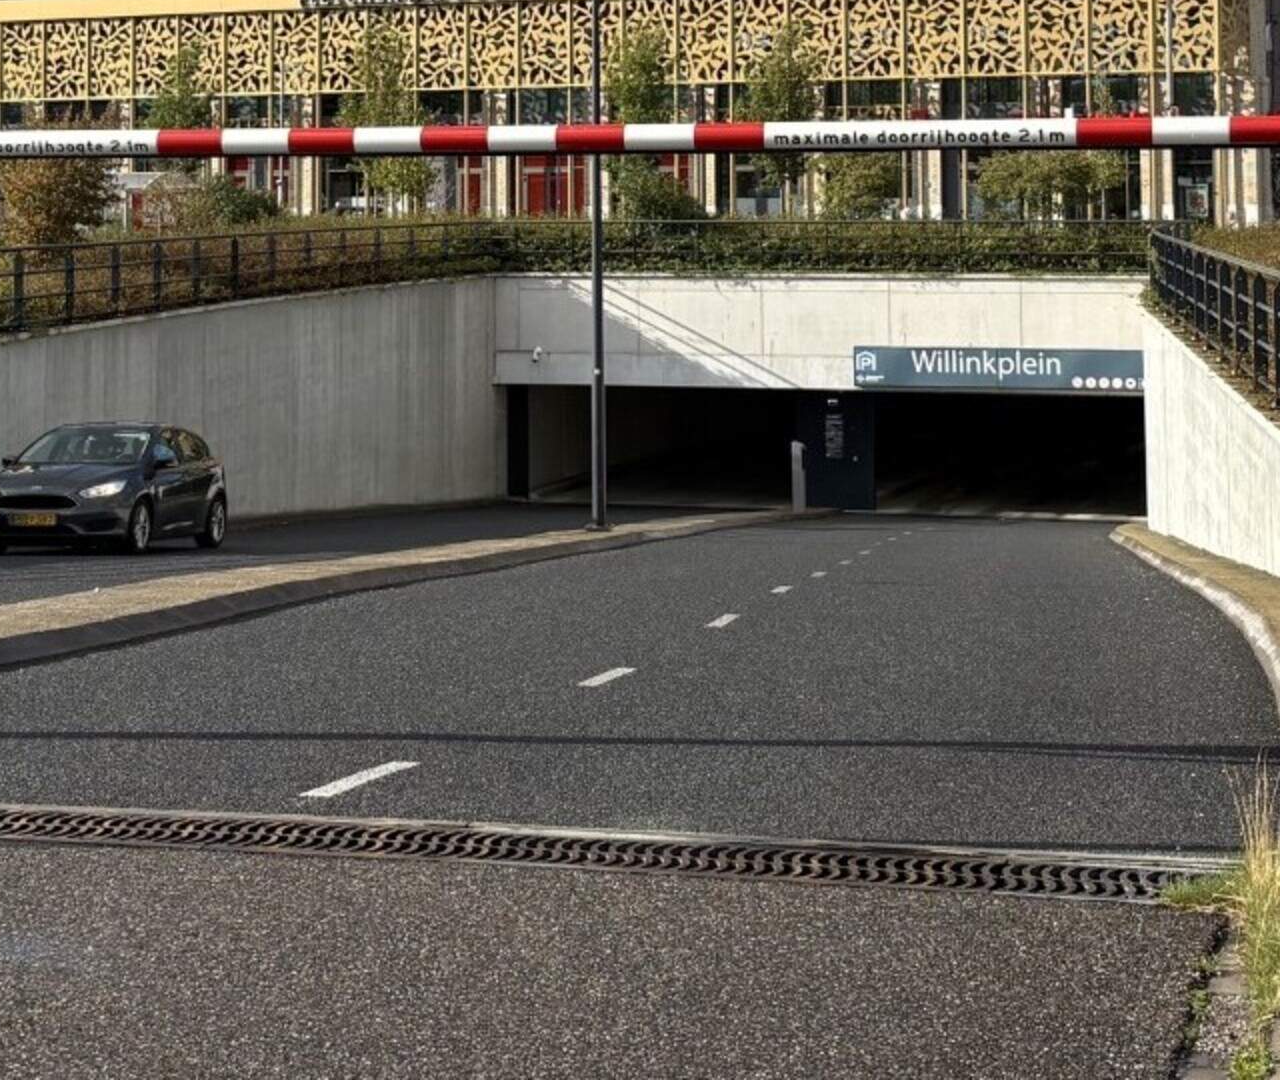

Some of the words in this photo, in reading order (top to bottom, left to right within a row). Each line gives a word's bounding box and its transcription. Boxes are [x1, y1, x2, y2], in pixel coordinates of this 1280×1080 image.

[773, 130, 869, 146] maximale
[877, 126, 1011, 145] doorrijhoogte
[912, 350, 1061, 381] Willinkplein
